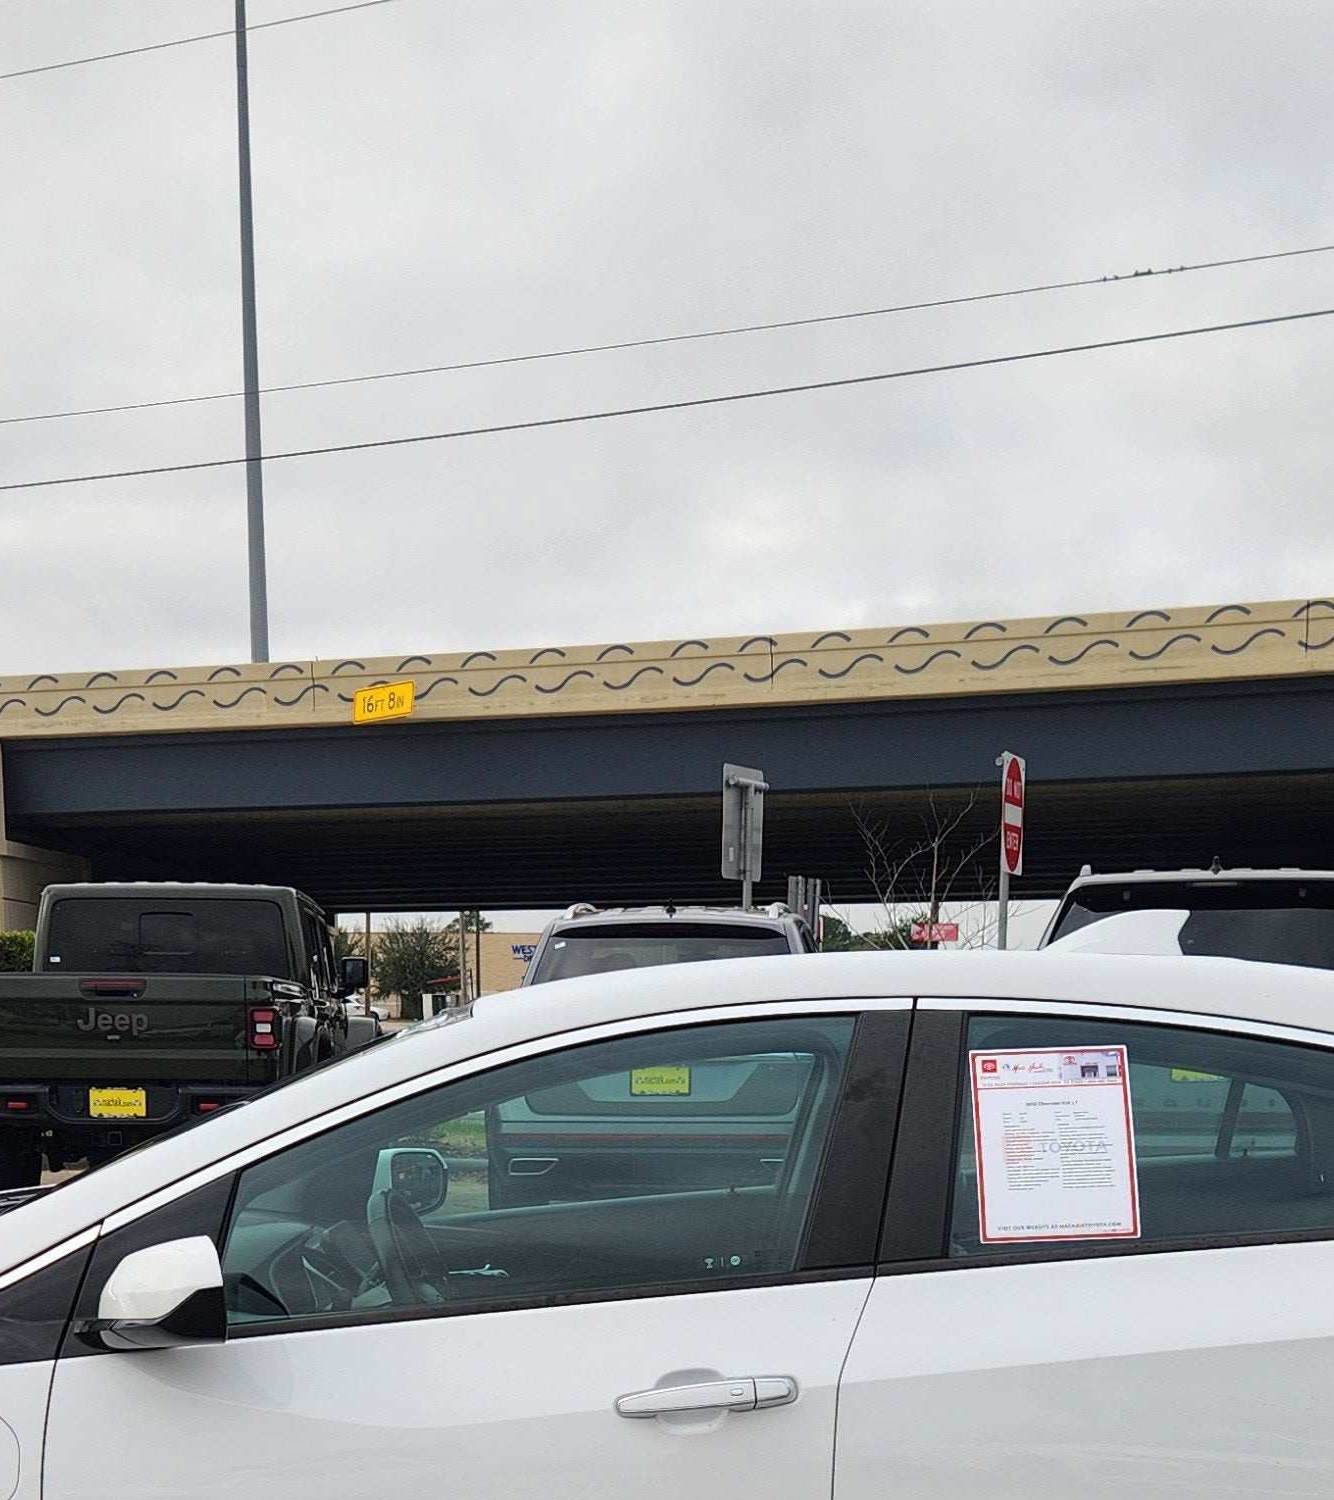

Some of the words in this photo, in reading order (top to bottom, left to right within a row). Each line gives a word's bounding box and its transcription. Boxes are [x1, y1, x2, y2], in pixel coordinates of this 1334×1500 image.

[1006, 830, 1019, 851] ENTER
[77, 1007, 149, 1036] Jeep
[1038, 1140, 1108, 1154] TOYOTA
